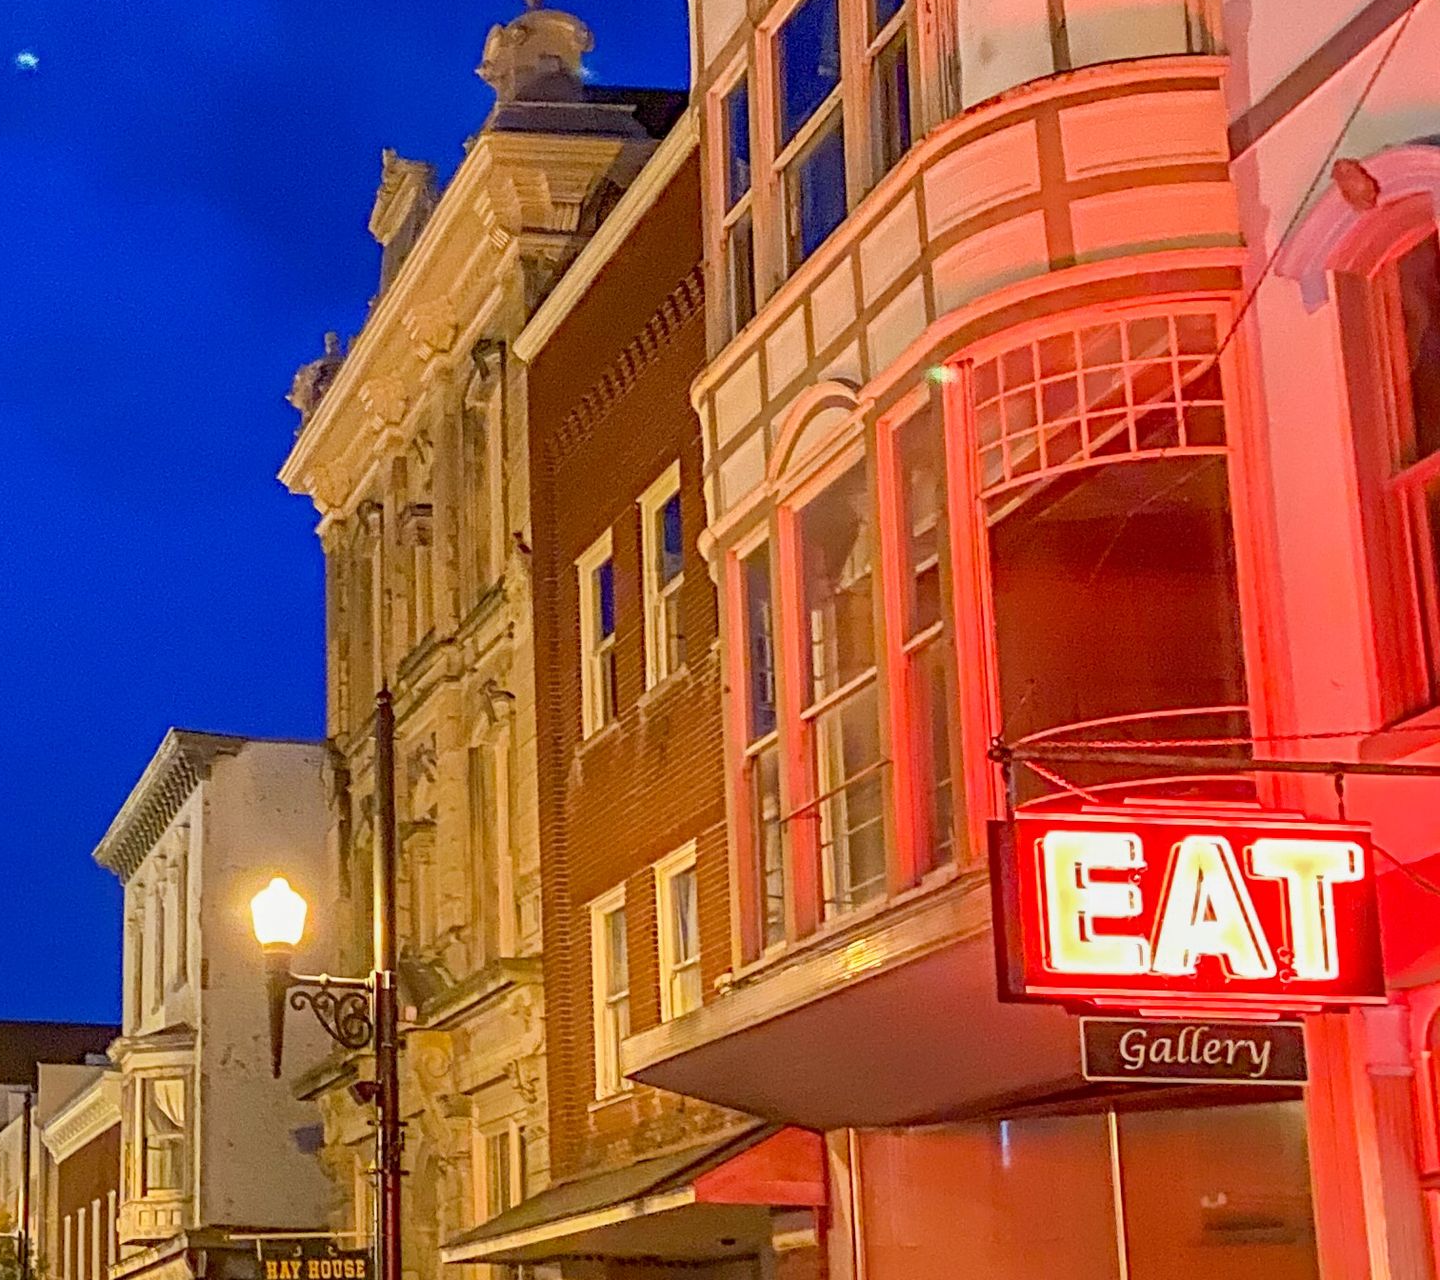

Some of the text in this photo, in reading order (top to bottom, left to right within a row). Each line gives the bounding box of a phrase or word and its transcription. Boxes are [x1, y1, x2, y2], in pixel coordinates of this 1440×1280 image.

[1034, 830, 1365, 982] EAT
[1118, 1026, 1272, 1078] Gallery
[265, 1259, 366, 1280] HAY HOUSE
